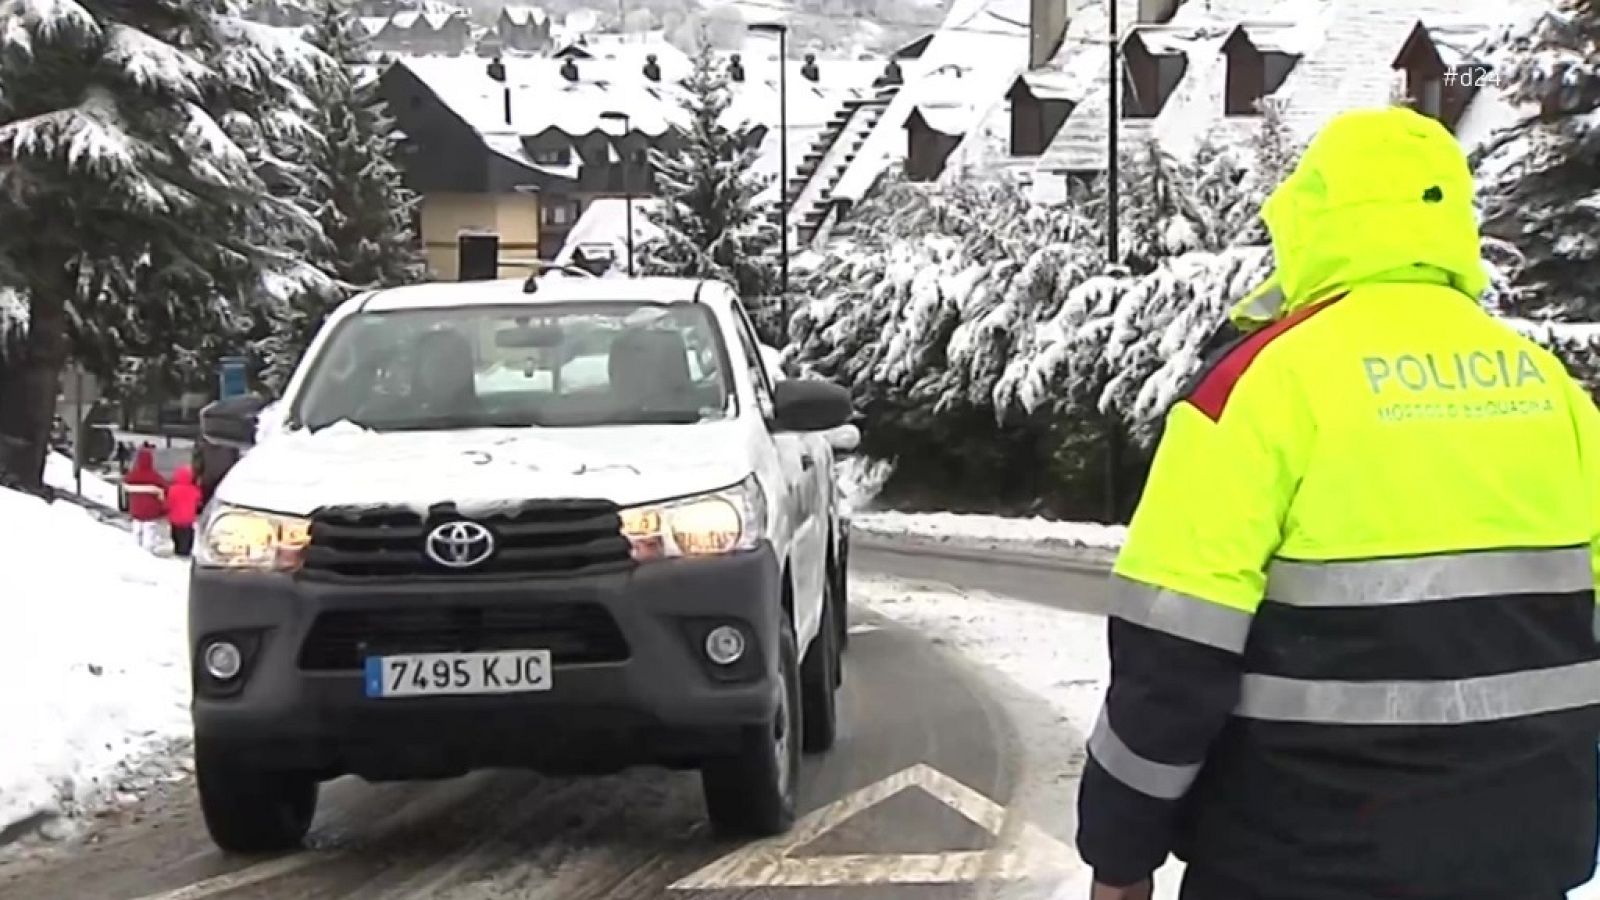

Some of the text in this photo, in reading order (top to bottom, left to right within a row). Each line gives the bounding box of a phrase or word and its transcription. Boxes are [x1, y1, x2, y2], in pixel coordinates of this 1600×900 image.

[1362, 350, 1546, 393] POLICIA
[390, 659, 470, 691] 7495
[482, 656, 543, 688] KJC
